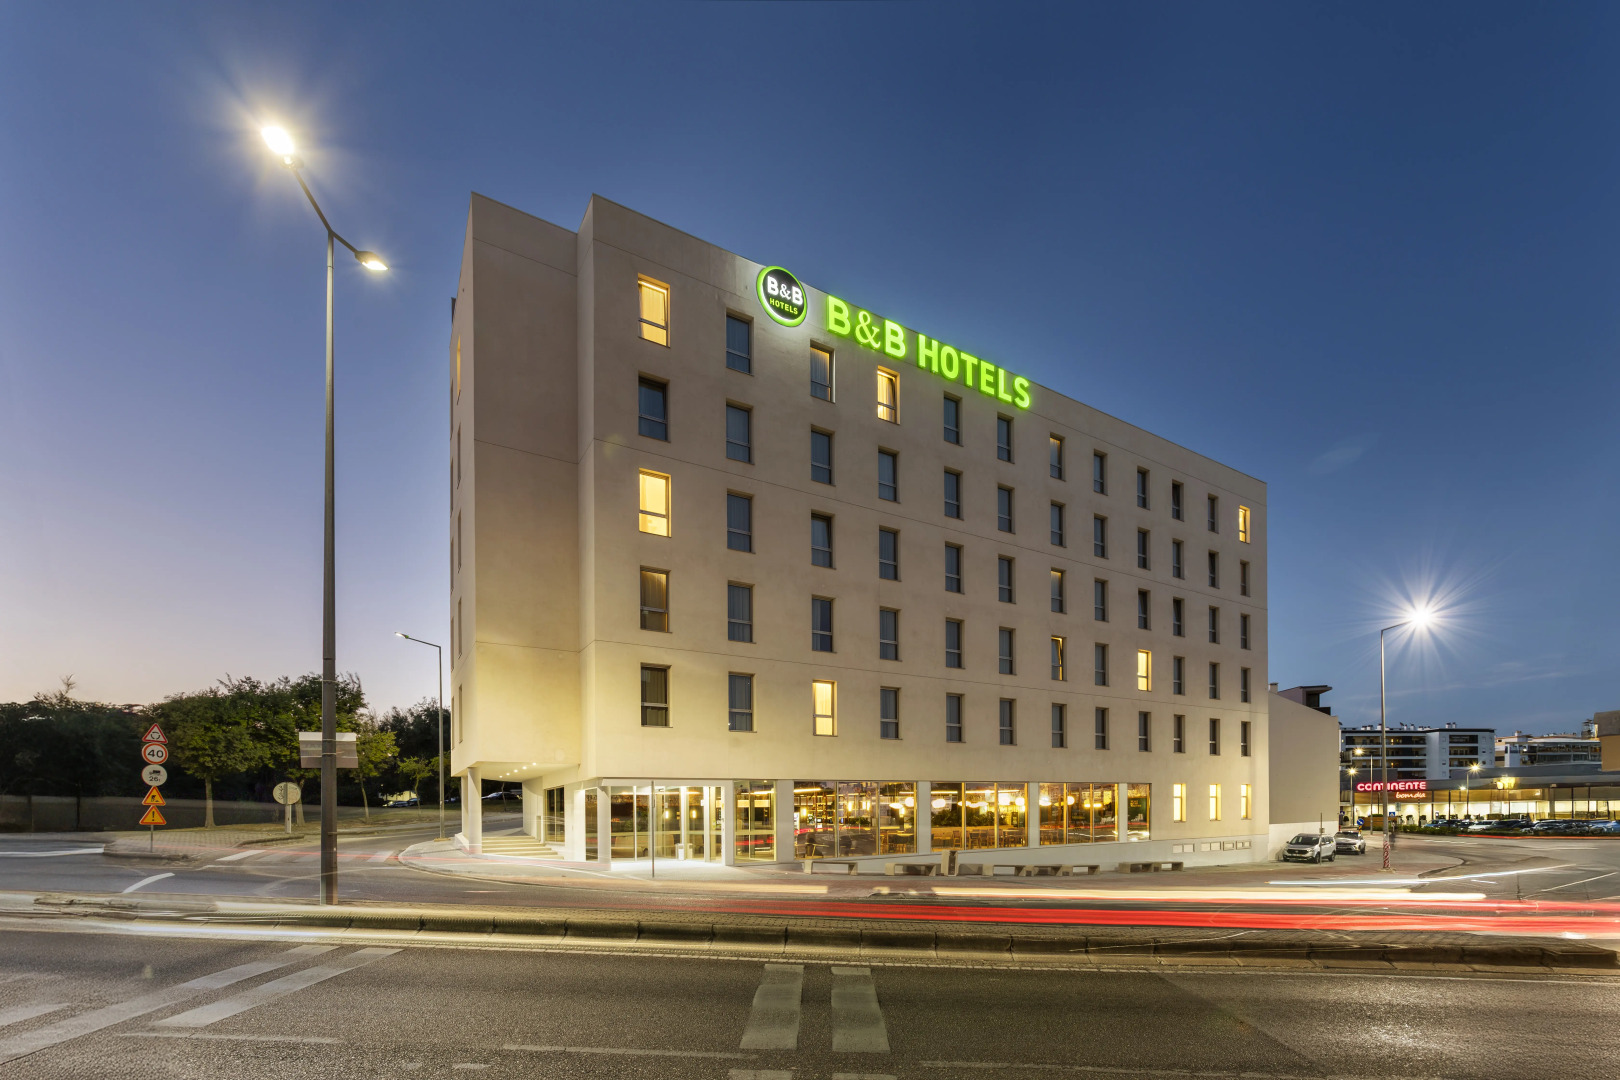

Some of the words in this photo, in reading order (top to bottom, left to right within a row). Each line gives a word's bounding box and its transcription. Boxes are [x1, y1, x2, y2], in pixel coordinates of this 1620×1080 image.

[767, 275, 803, 306] B&B
[769, 297, 799, 315] HOTELS
[826, 295, 907, 358] B&B
[917, 333, 1031, 410] HOTELS
[147, 749, 164, 758] 40
